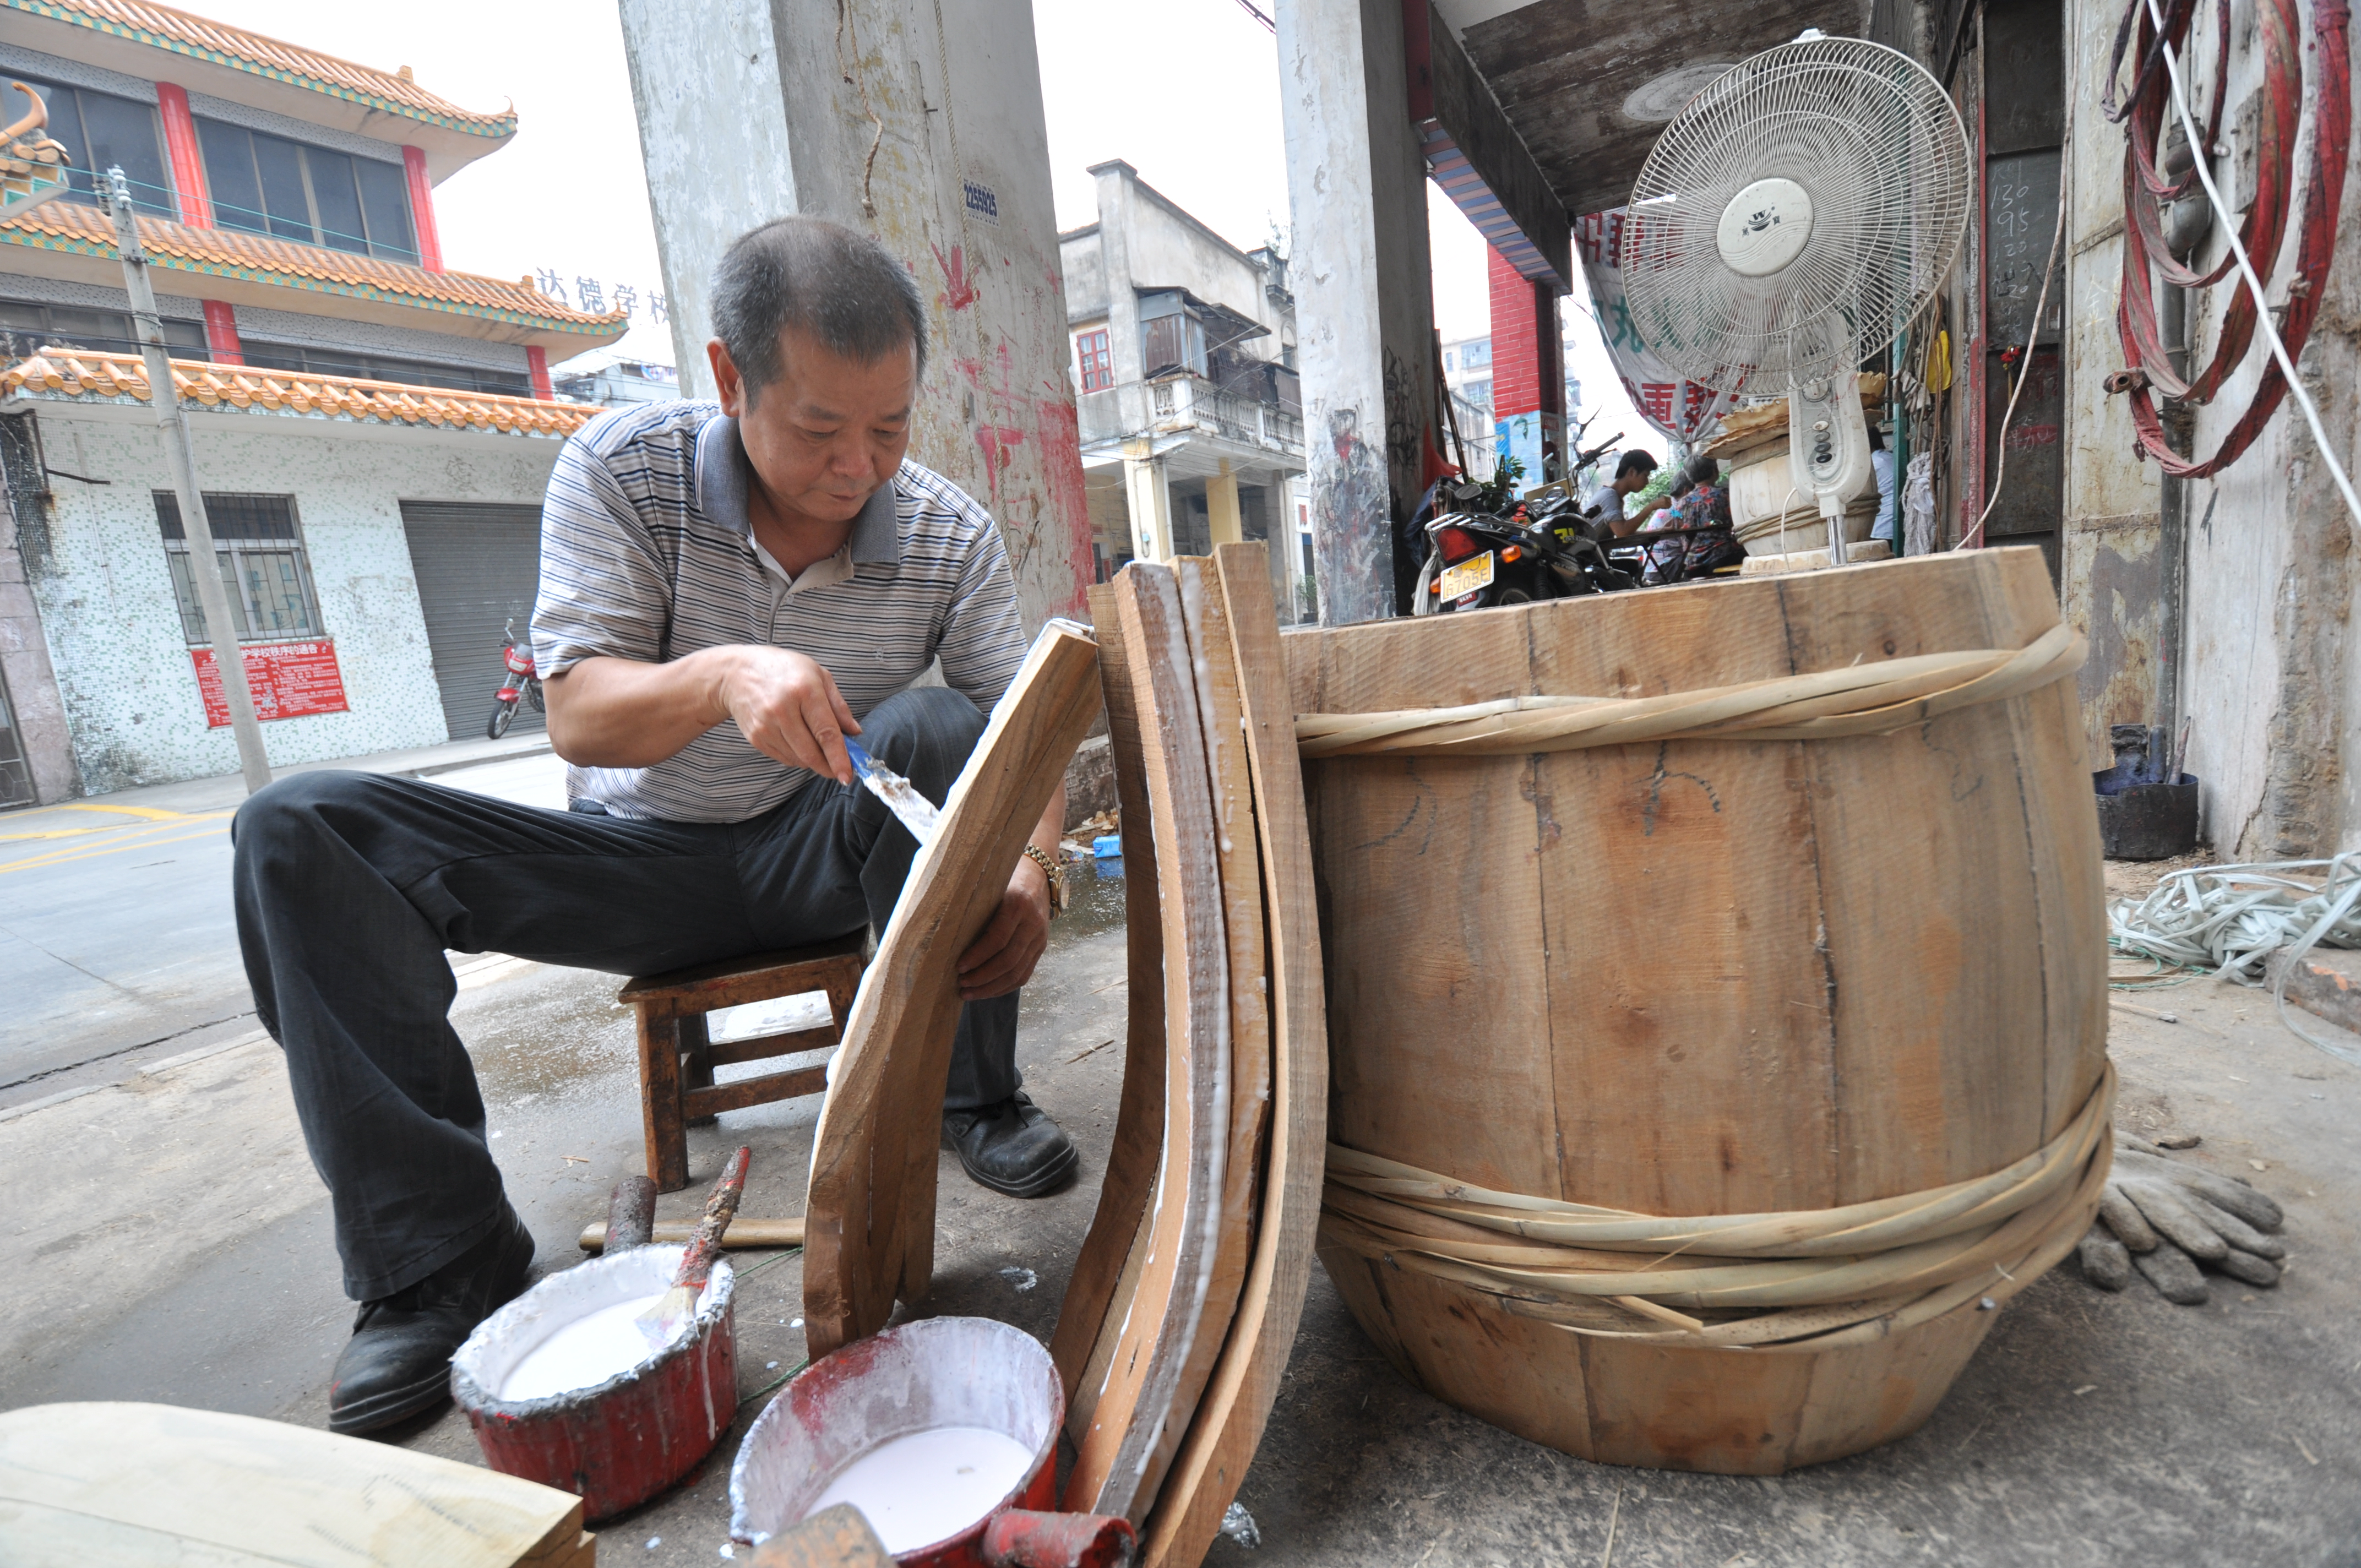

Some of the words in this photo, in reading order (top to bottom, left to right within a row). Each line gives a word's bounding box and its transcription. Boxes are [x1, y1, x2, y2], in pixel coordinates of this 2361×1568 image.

[964, 183, 997, 217] 2255925
[1990, 184, 2029, 209] 130
[1751, 209, 1766, 221] W
[1996, 207, 2030, 237] 95
[1446, 568, 1488, 596] G705E
